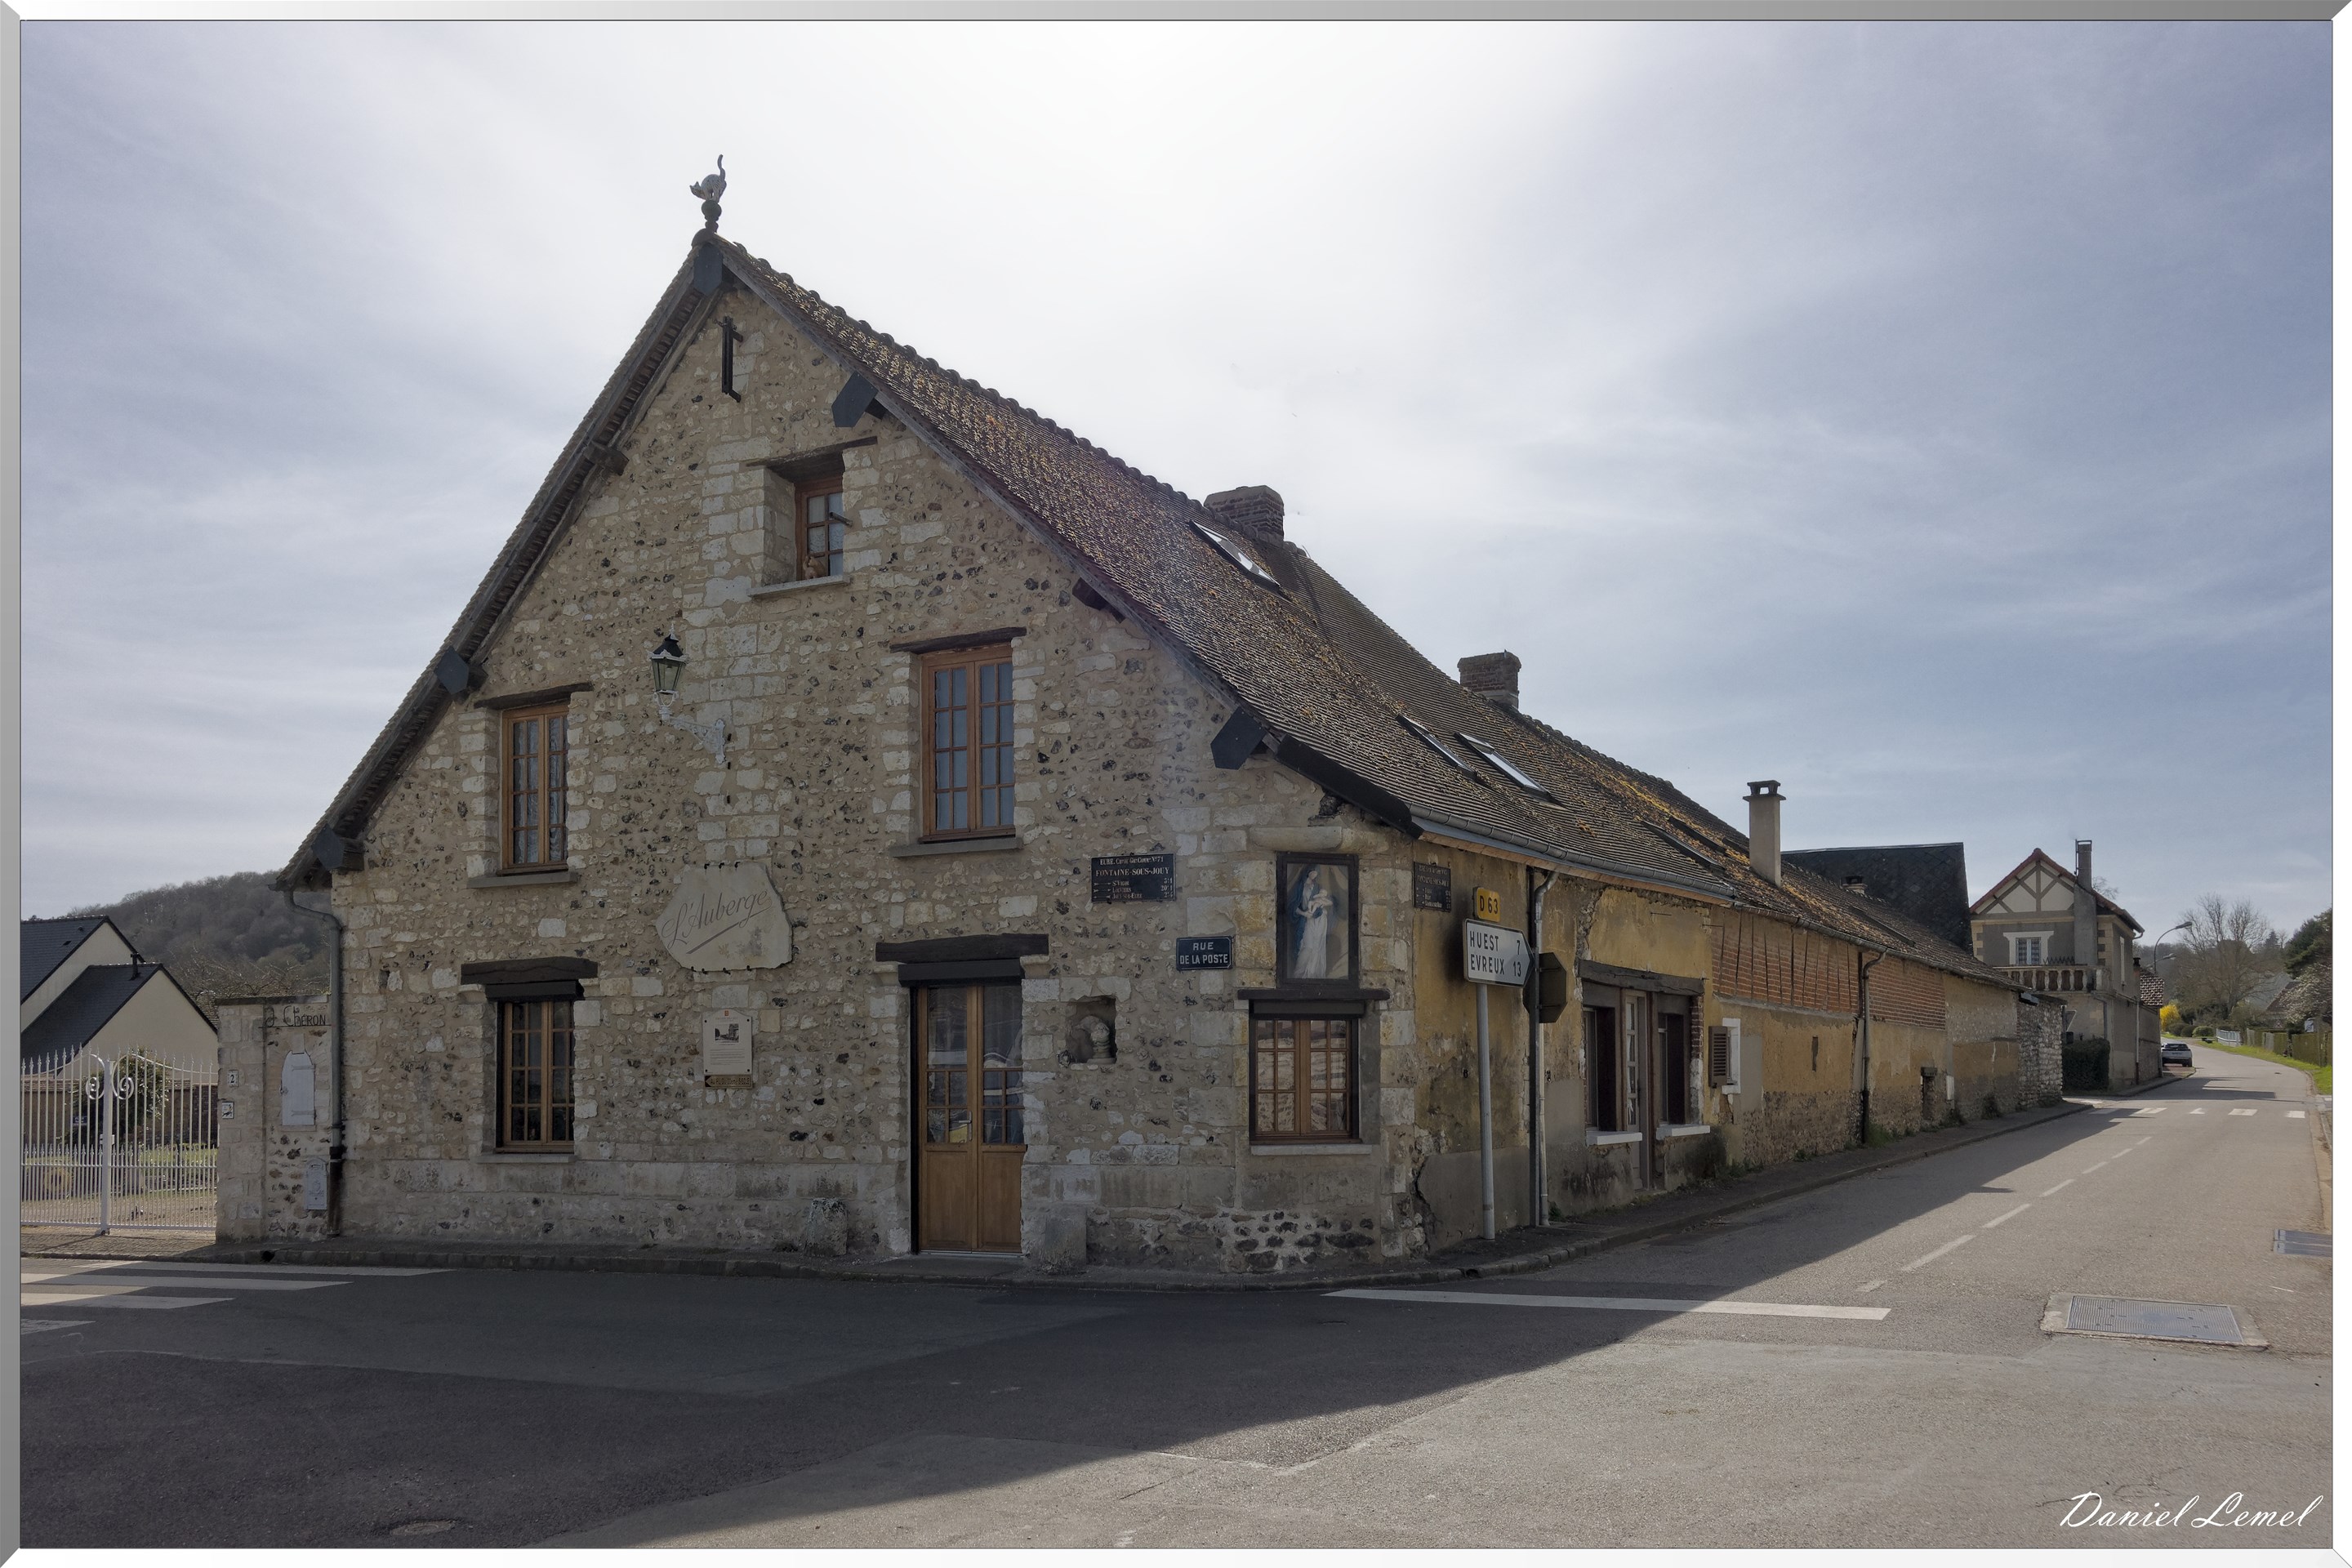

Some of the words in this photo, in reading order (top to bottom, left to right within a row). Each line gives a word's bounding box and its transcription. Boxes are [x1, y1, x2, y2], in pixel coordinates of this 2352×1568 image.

[1480, 895, 1485, 911] D
[1488, 898, 1499, 915] 63
[662, 889, 773, 949] L'Auberge
[1192, 942, 1214, 951] RUE
[1470, 930, 1499, 952] HUEST
[1517, 939, 1521, 956] 7
[1179, 955, 1189, 964] DE
[1192, 955, 1200, 964] LA
[1202, 953, 1228, 964] POSTE
[1471, 953, 1504, 975] EVREUX
[1512, 961, 1521, 978] 13
[230, 1074, 235, 1084] 2
